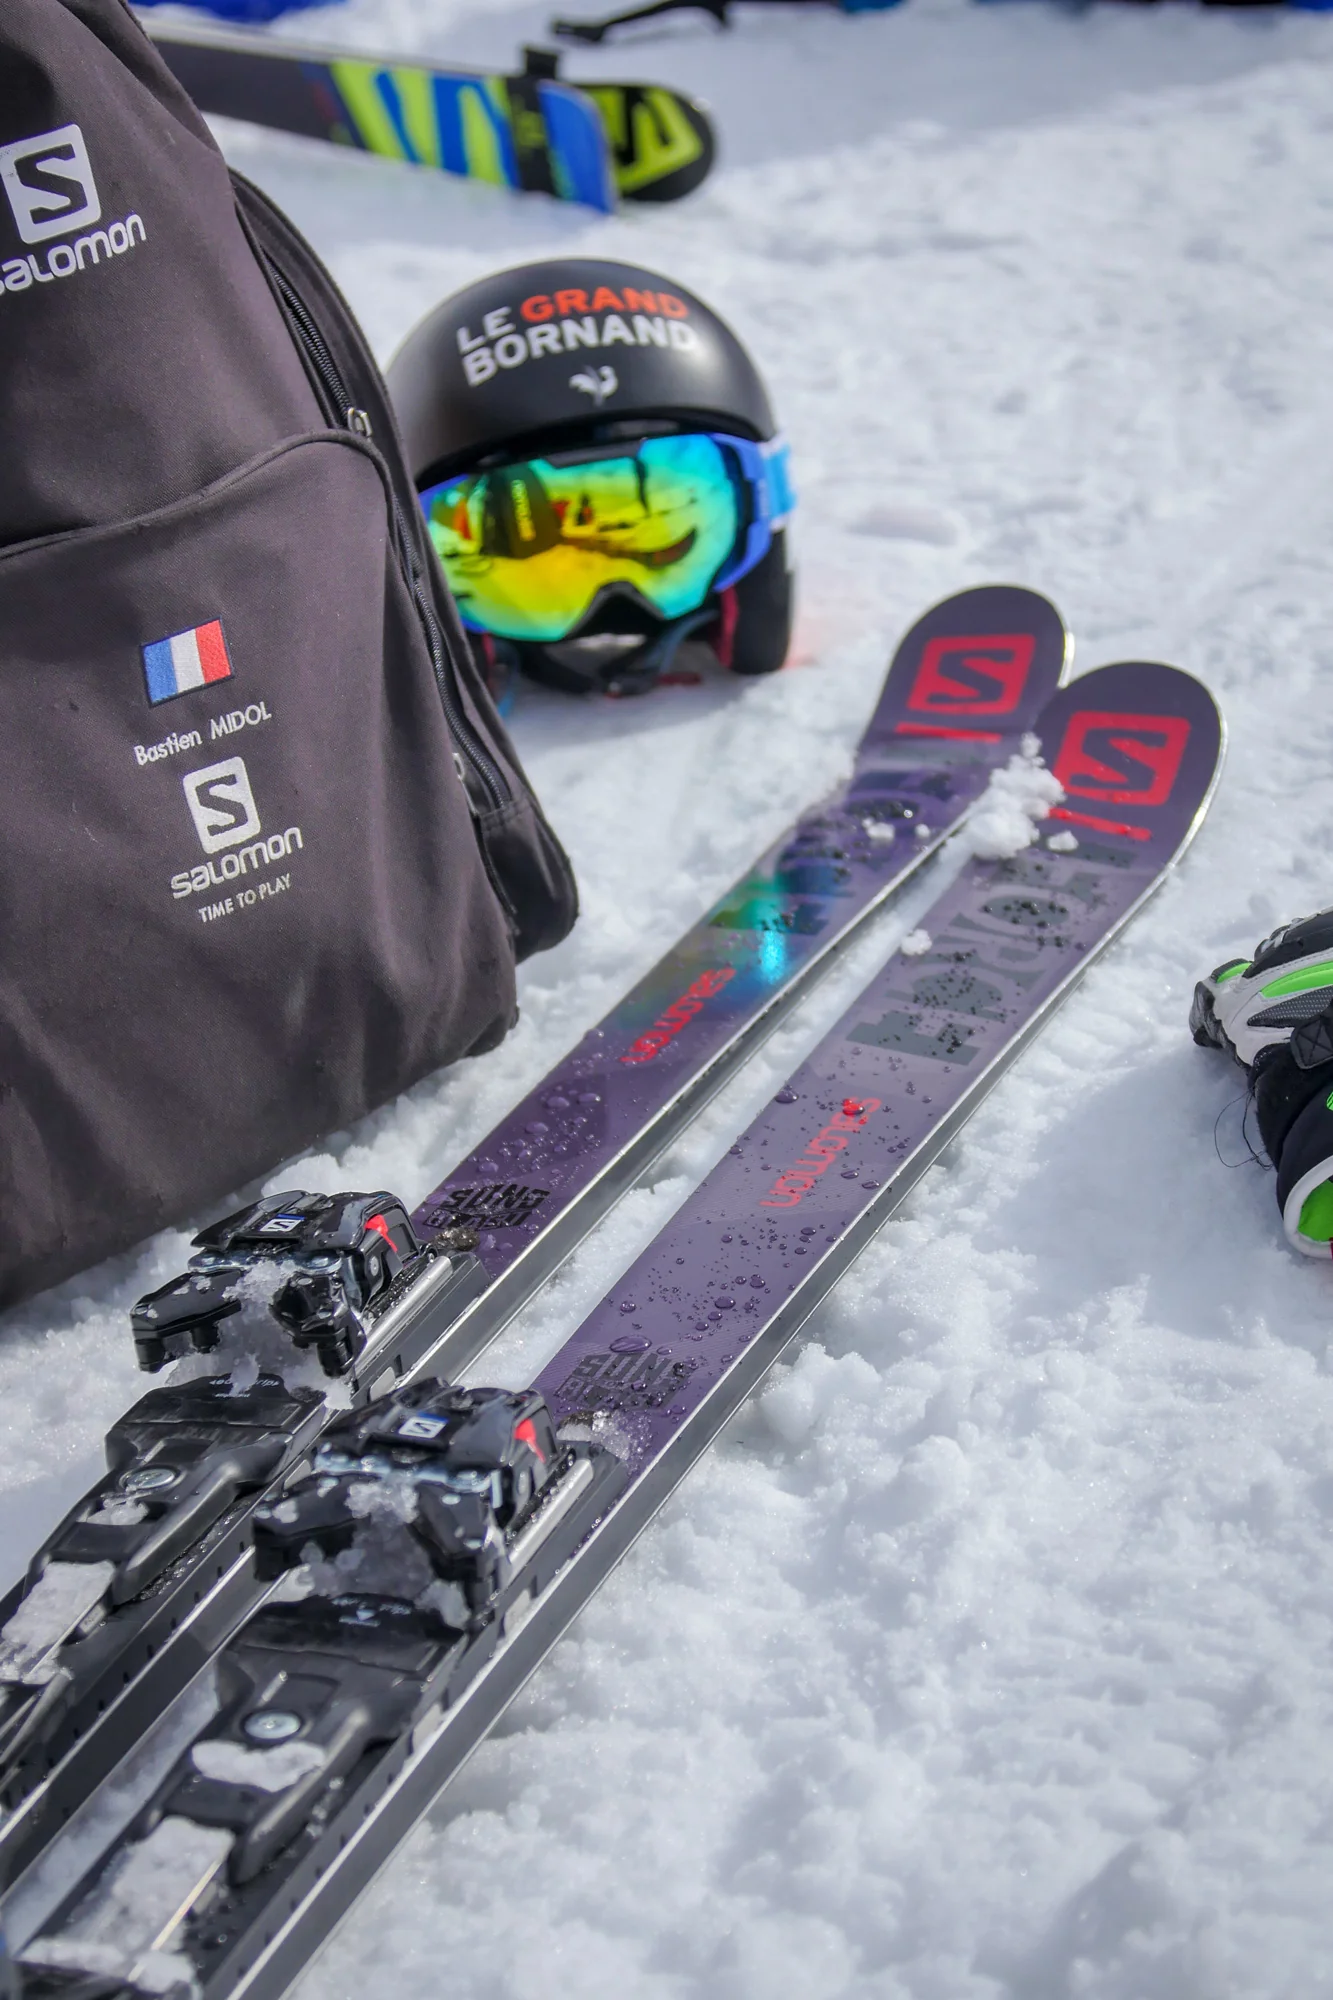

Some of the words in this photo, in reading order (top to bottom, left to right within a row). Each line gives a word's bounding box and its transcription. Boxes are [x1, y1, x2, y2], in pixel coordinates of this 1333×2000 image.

[456, 305, 517, 353] LE
[520, 285, 689, 323] GRAND
[461, 313, 700, 387] BORNAND
[133, 729, 203, 766] Bastien
[209, 700, 272, 741] MIDOL
[170, 826, 304, 899] salomon
[198, 897, 235, 923] TIME
[235, 889, 257, 909] TO
[258, 872, 292, 900] PLAY
